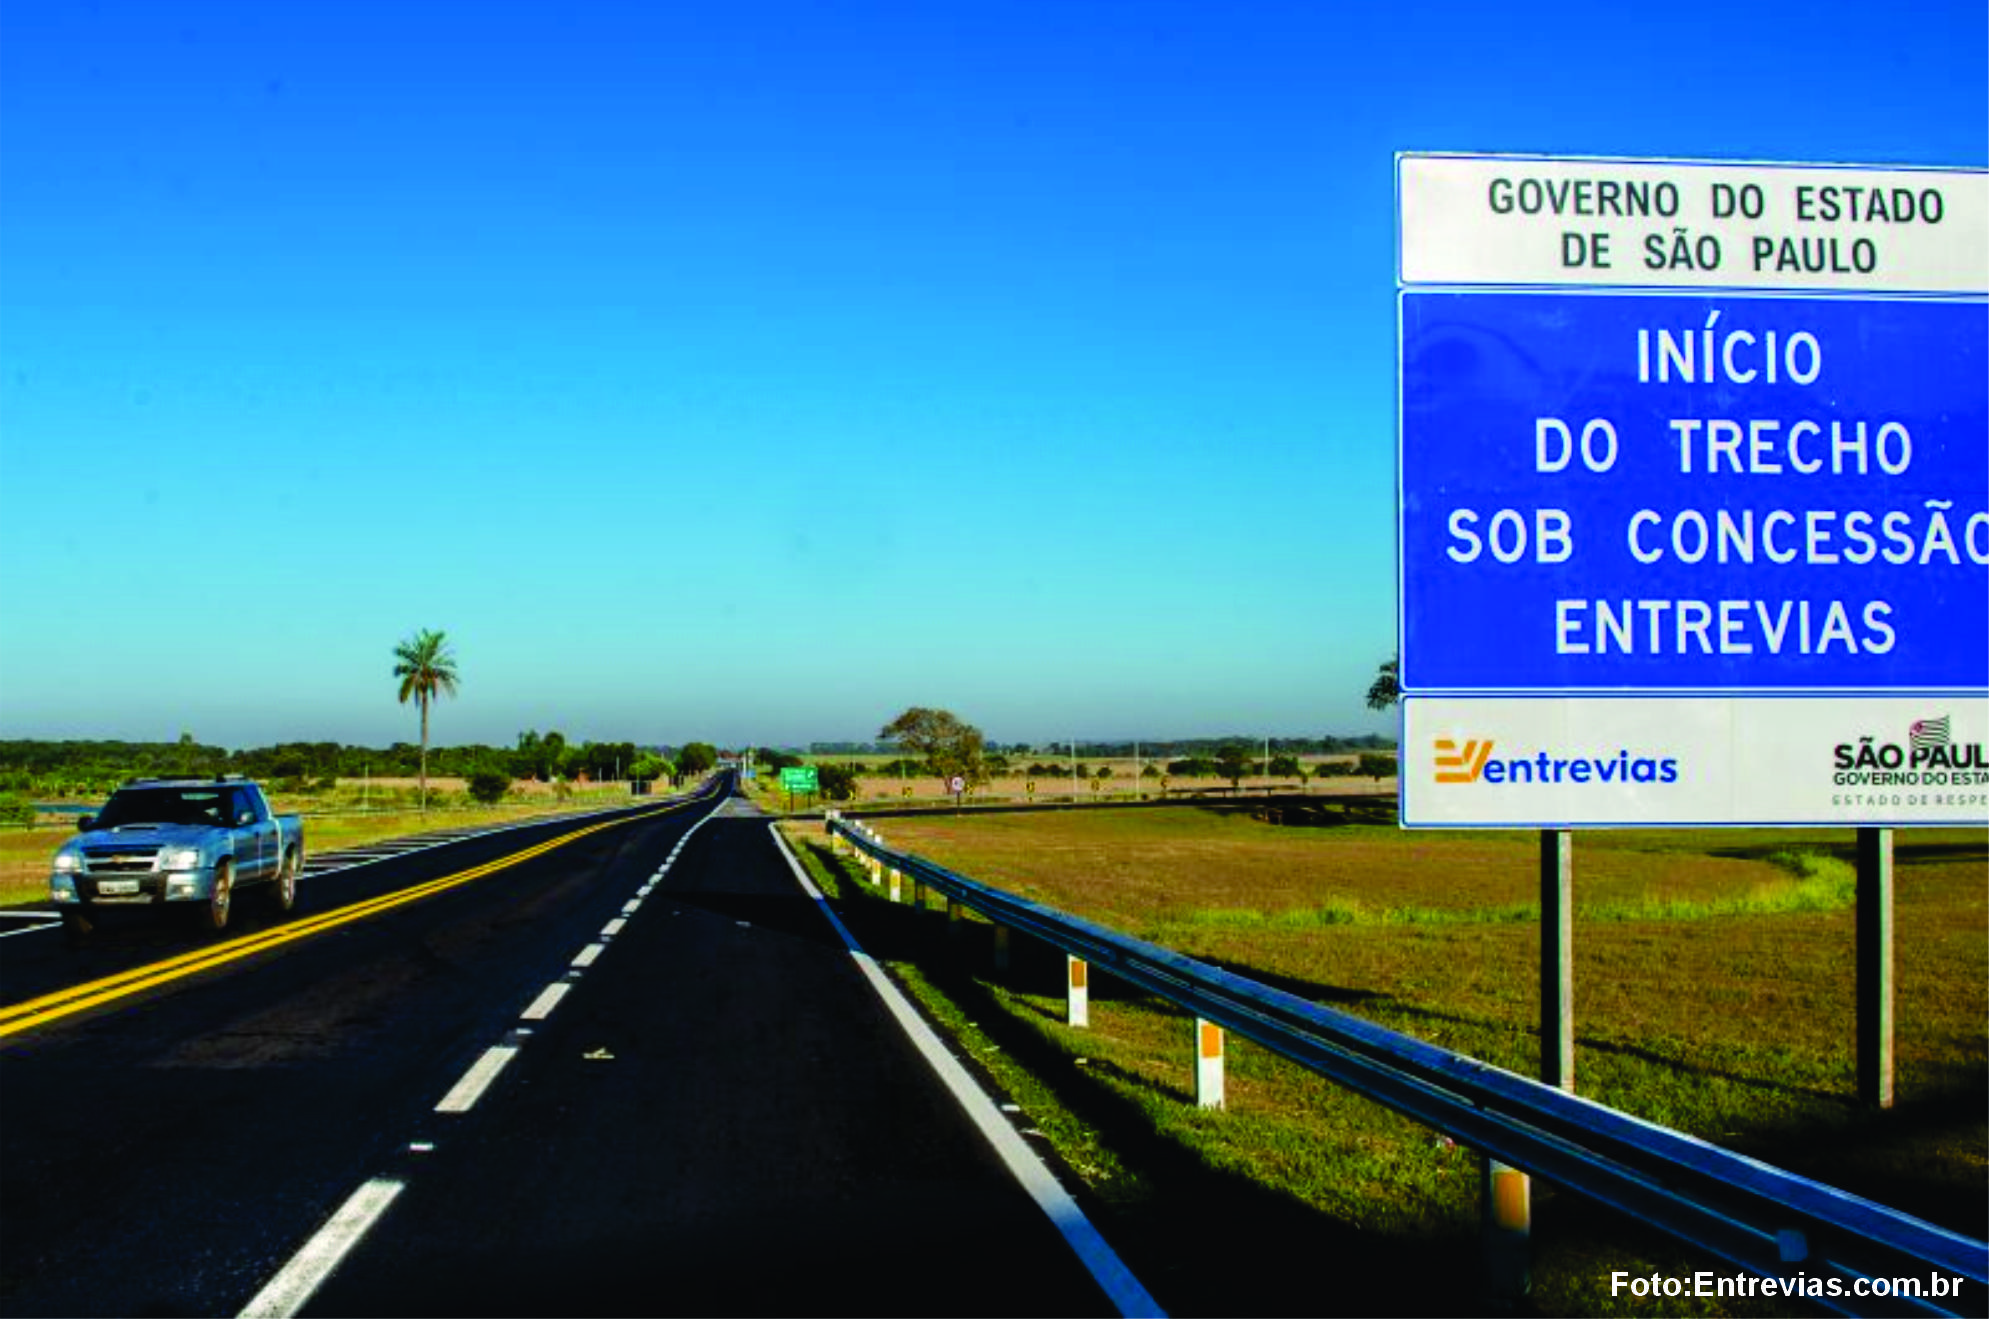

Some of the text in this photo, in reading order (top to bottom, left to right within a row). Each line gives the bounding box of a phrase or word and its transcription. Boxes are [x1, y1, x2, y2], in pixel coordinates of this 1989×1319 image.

[1488, 178, 1944, 225] GOVERNO DO ESTADO
[1562, 227, 1877, 274] DE SÃO PAULO
[1637, 309, 1822, 385] INÍCIO
[1535, 417, 1913, 476] DO TRECHO
[1446, 499, 1988, 565] SOB CONCESSÃO
[1555, 599, 1897, 655] ENTREVIAS
[1482, 749, 1679, 784] entrevias
[1833, 734, 1905, 770] SÃO
[1832, 794, 1901, 806] ESTADO
[1908, 794, 1928, 806] DE
[1833, 771, 1919, 786] GOVERNO
[1921, 771, 1949, 786] DO
